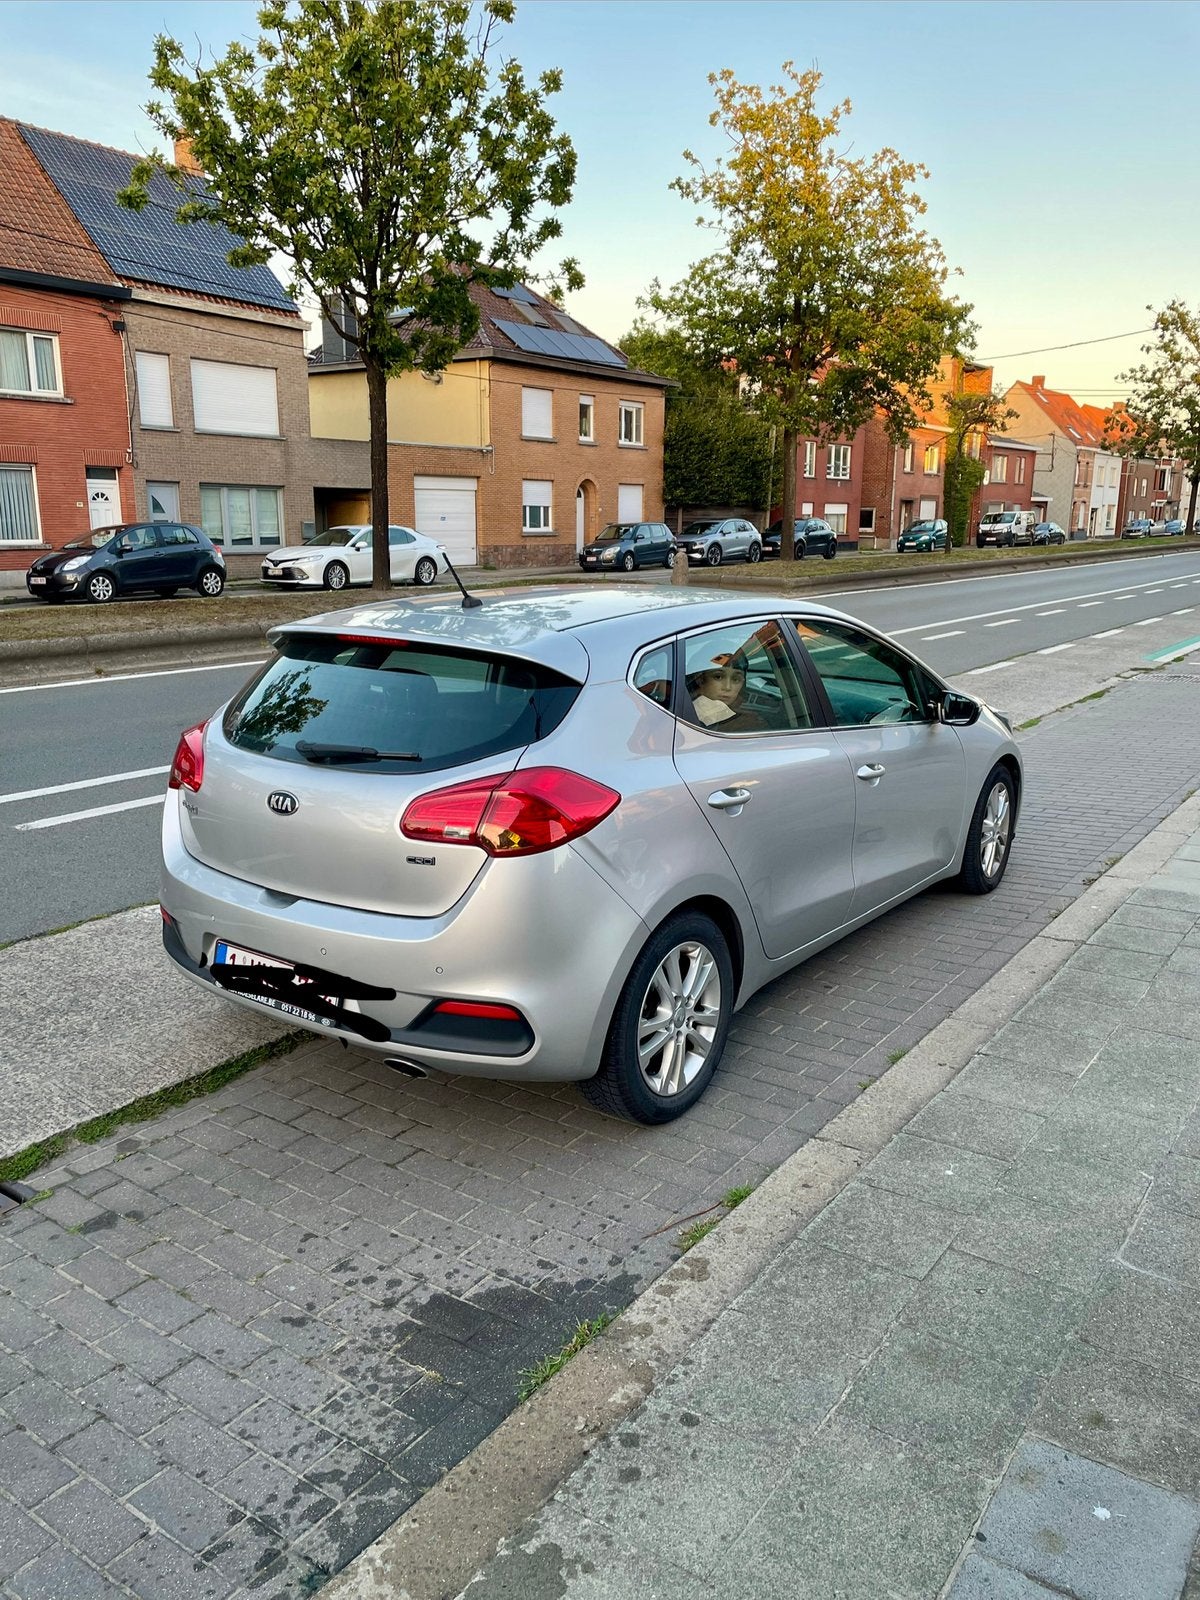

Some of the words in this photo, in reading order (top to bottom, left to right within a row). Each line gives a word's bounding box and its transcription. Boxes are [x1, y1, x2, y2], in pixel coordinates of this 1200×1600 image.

[271, 794, 292, 811] KIA
[281, 1003, 292, 1013] 051
[292, 1007, 300, 1016] 22
[300, 1010, 308, 1019] 18
